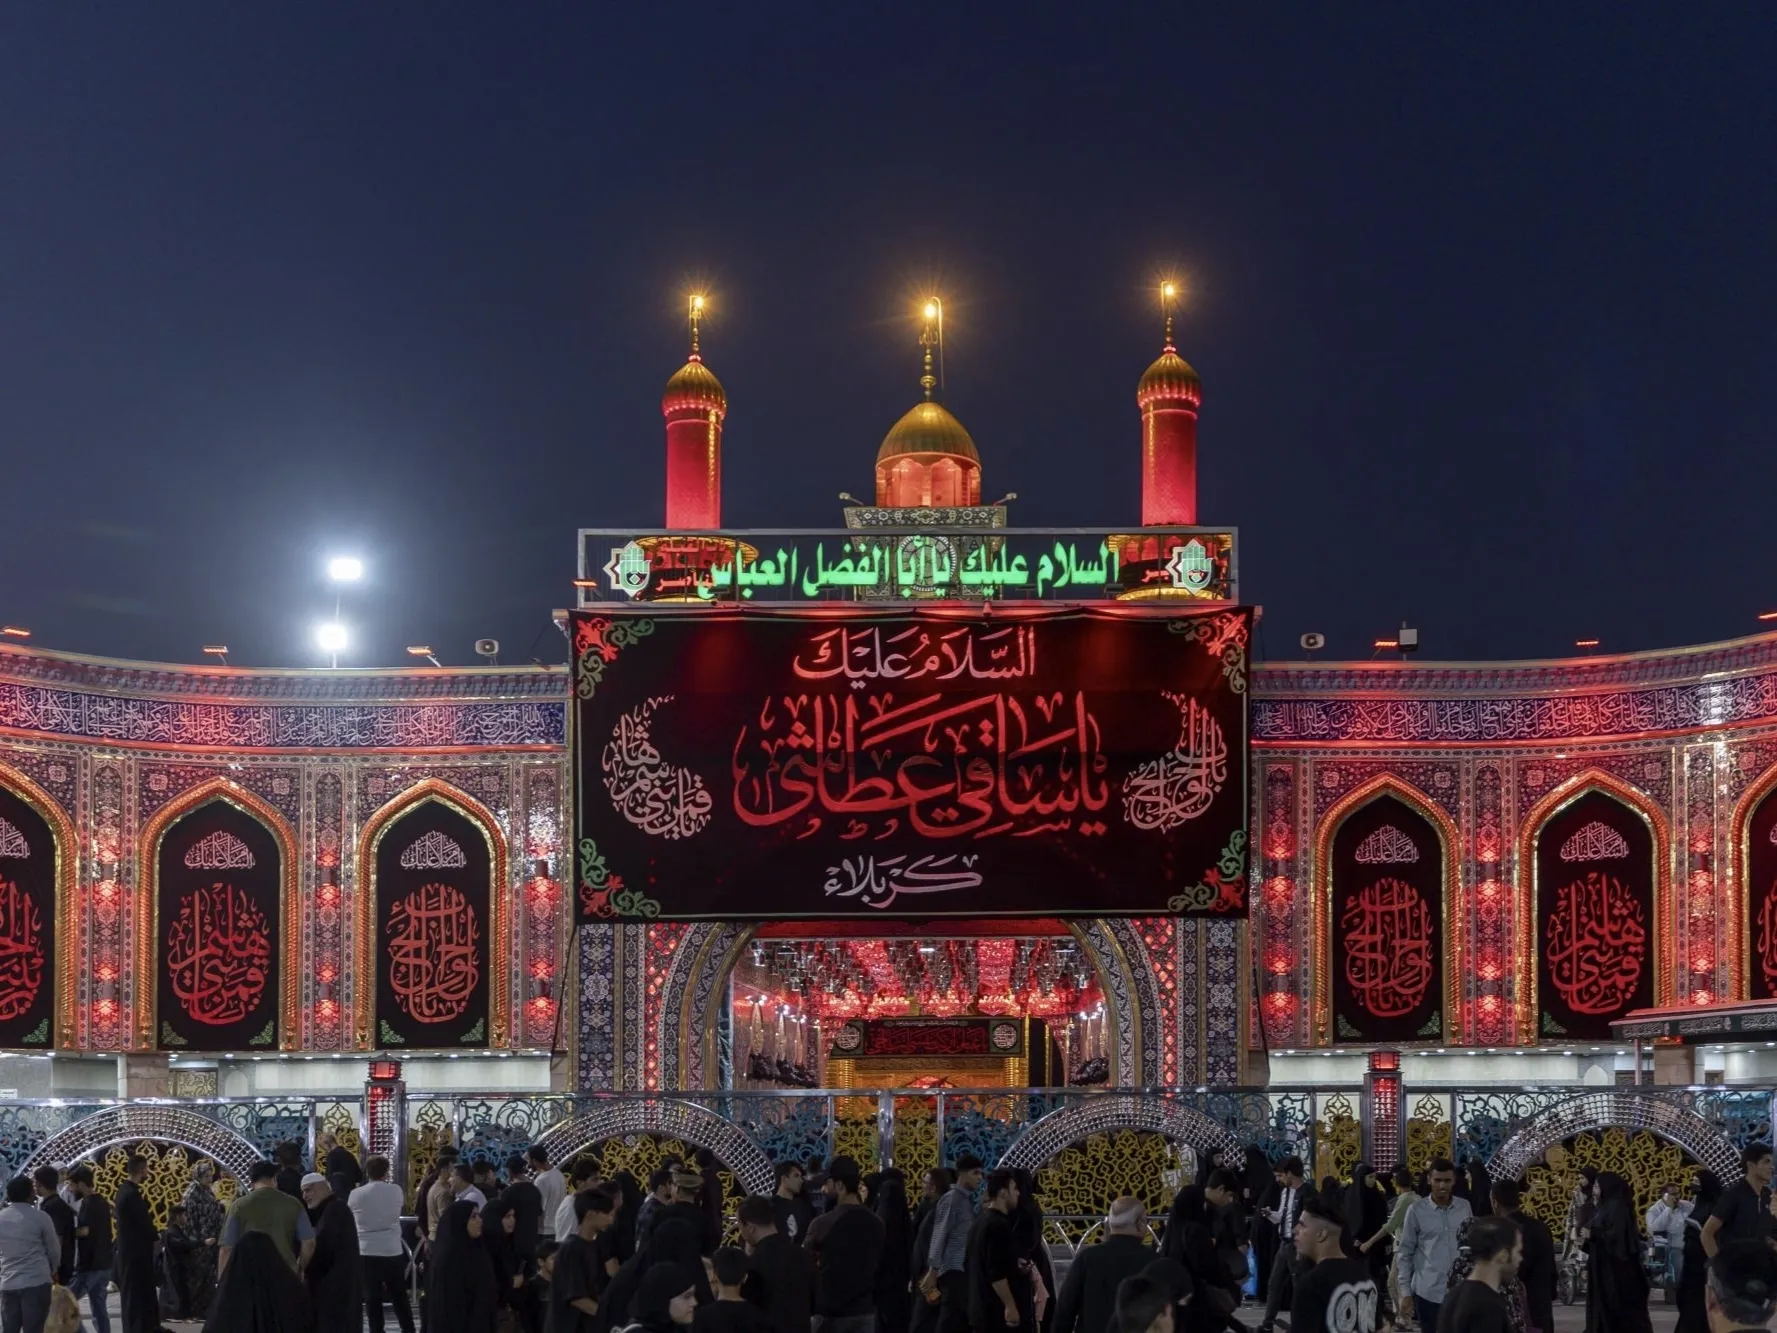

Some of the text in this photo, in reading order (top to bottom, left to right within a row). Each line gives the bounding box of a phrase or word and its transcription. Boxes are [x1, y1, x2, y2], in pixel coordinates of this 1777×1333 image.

[697, 546, 798, 599] العباس
[803, 542, 890, 597] الفضل
[959, 542, 1029, 596] عليك
[1037, 541, 1119, 598] السلام
